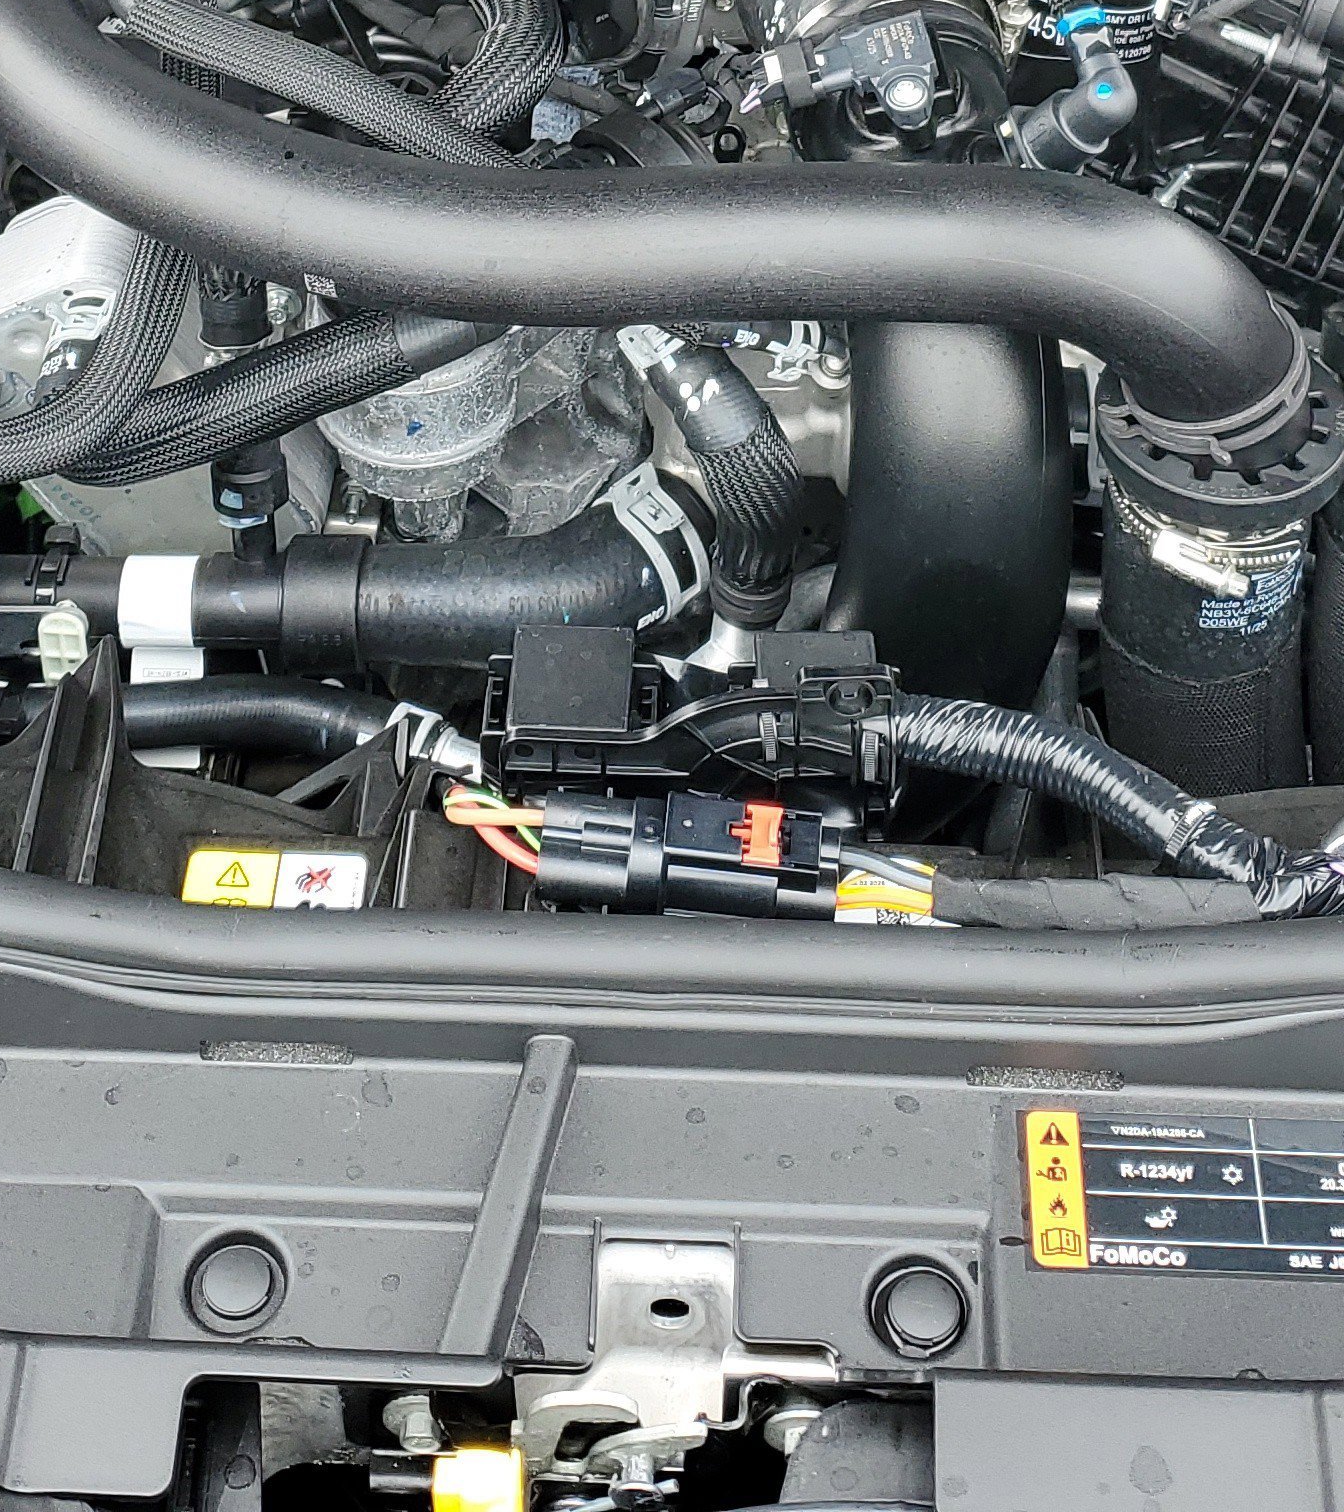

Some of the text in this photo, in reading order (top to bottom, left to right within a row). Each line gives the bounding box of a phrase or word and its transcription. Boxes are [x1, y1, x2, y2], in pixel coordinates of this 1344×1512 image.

[1201, 599, 1240, 609] Made
[1199, 616, 1250, 628] D05WE
[1240, 619, 1268, 636] 11/25
[1120, 1162, 1195, 1183] R-1234yf
[1089, 1244, 1187, 1268] FoMoCo
[1288, 1254, 1324, 1269] SAE
